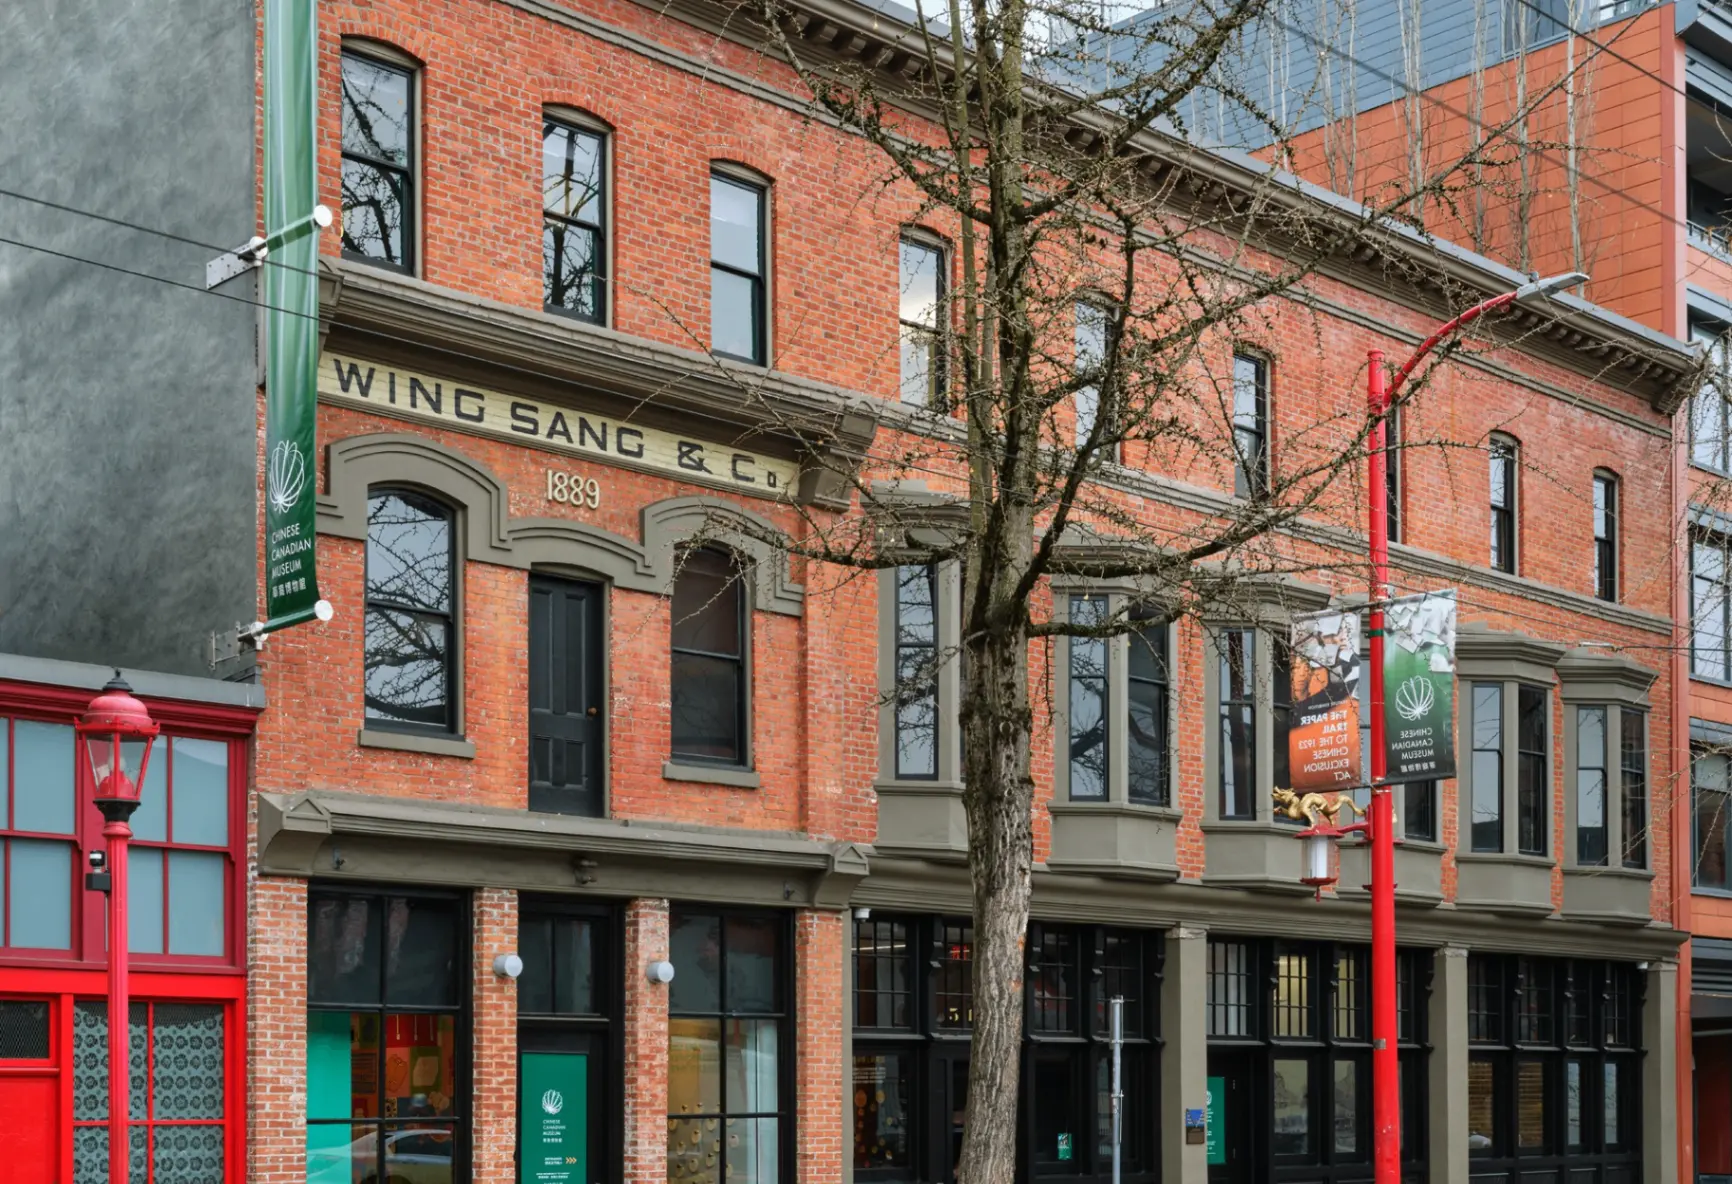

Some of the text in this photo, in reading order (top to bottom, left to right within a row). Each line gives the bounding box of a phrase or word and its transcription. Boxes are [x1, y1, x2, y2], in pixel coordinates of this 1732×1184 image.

[333, 358, 485, 423] WING
[510, 402, 644, 459] SANG
[677, 440, 713, 475] &
[547, 470, 600, 509] 1889
[272, 523, 300, 544] CHINESE
[272, 538, 312, 561] CANADIAN
[271, 559, 302, 579] MUSEUM
